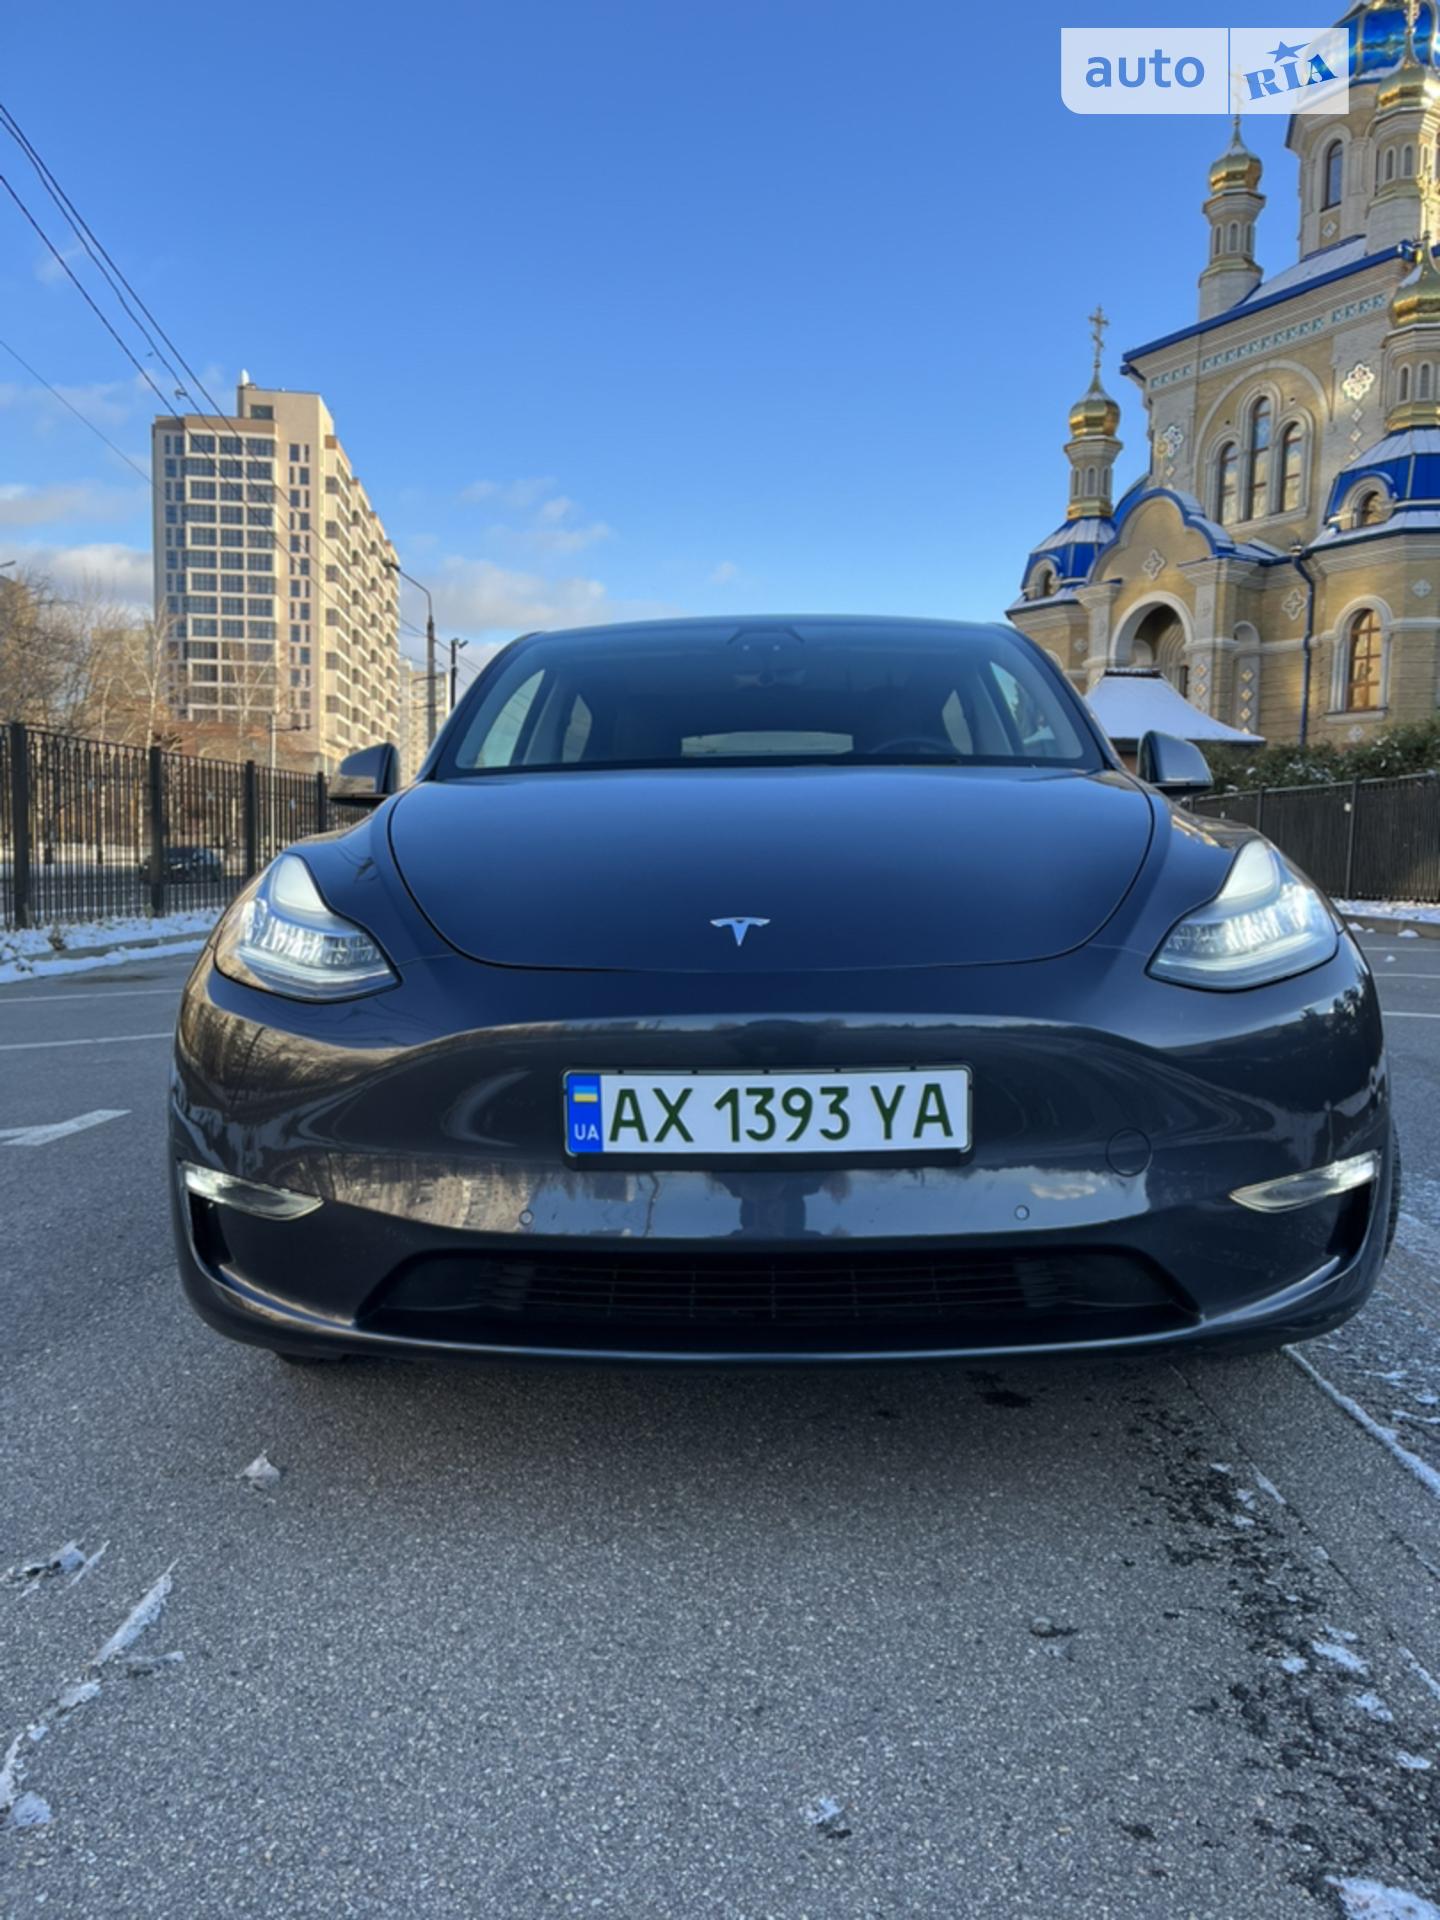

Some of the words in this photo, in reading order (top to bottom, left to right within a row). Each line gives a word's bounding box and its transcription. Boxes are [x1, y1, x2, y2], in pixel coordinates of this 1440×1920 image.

[574, 1123, 600, 1141] UA
[609, 1087, 694, 1143] AX
[713, 1086, 851, 1143] 1393
[870, 1083, 954, 1140] YA
